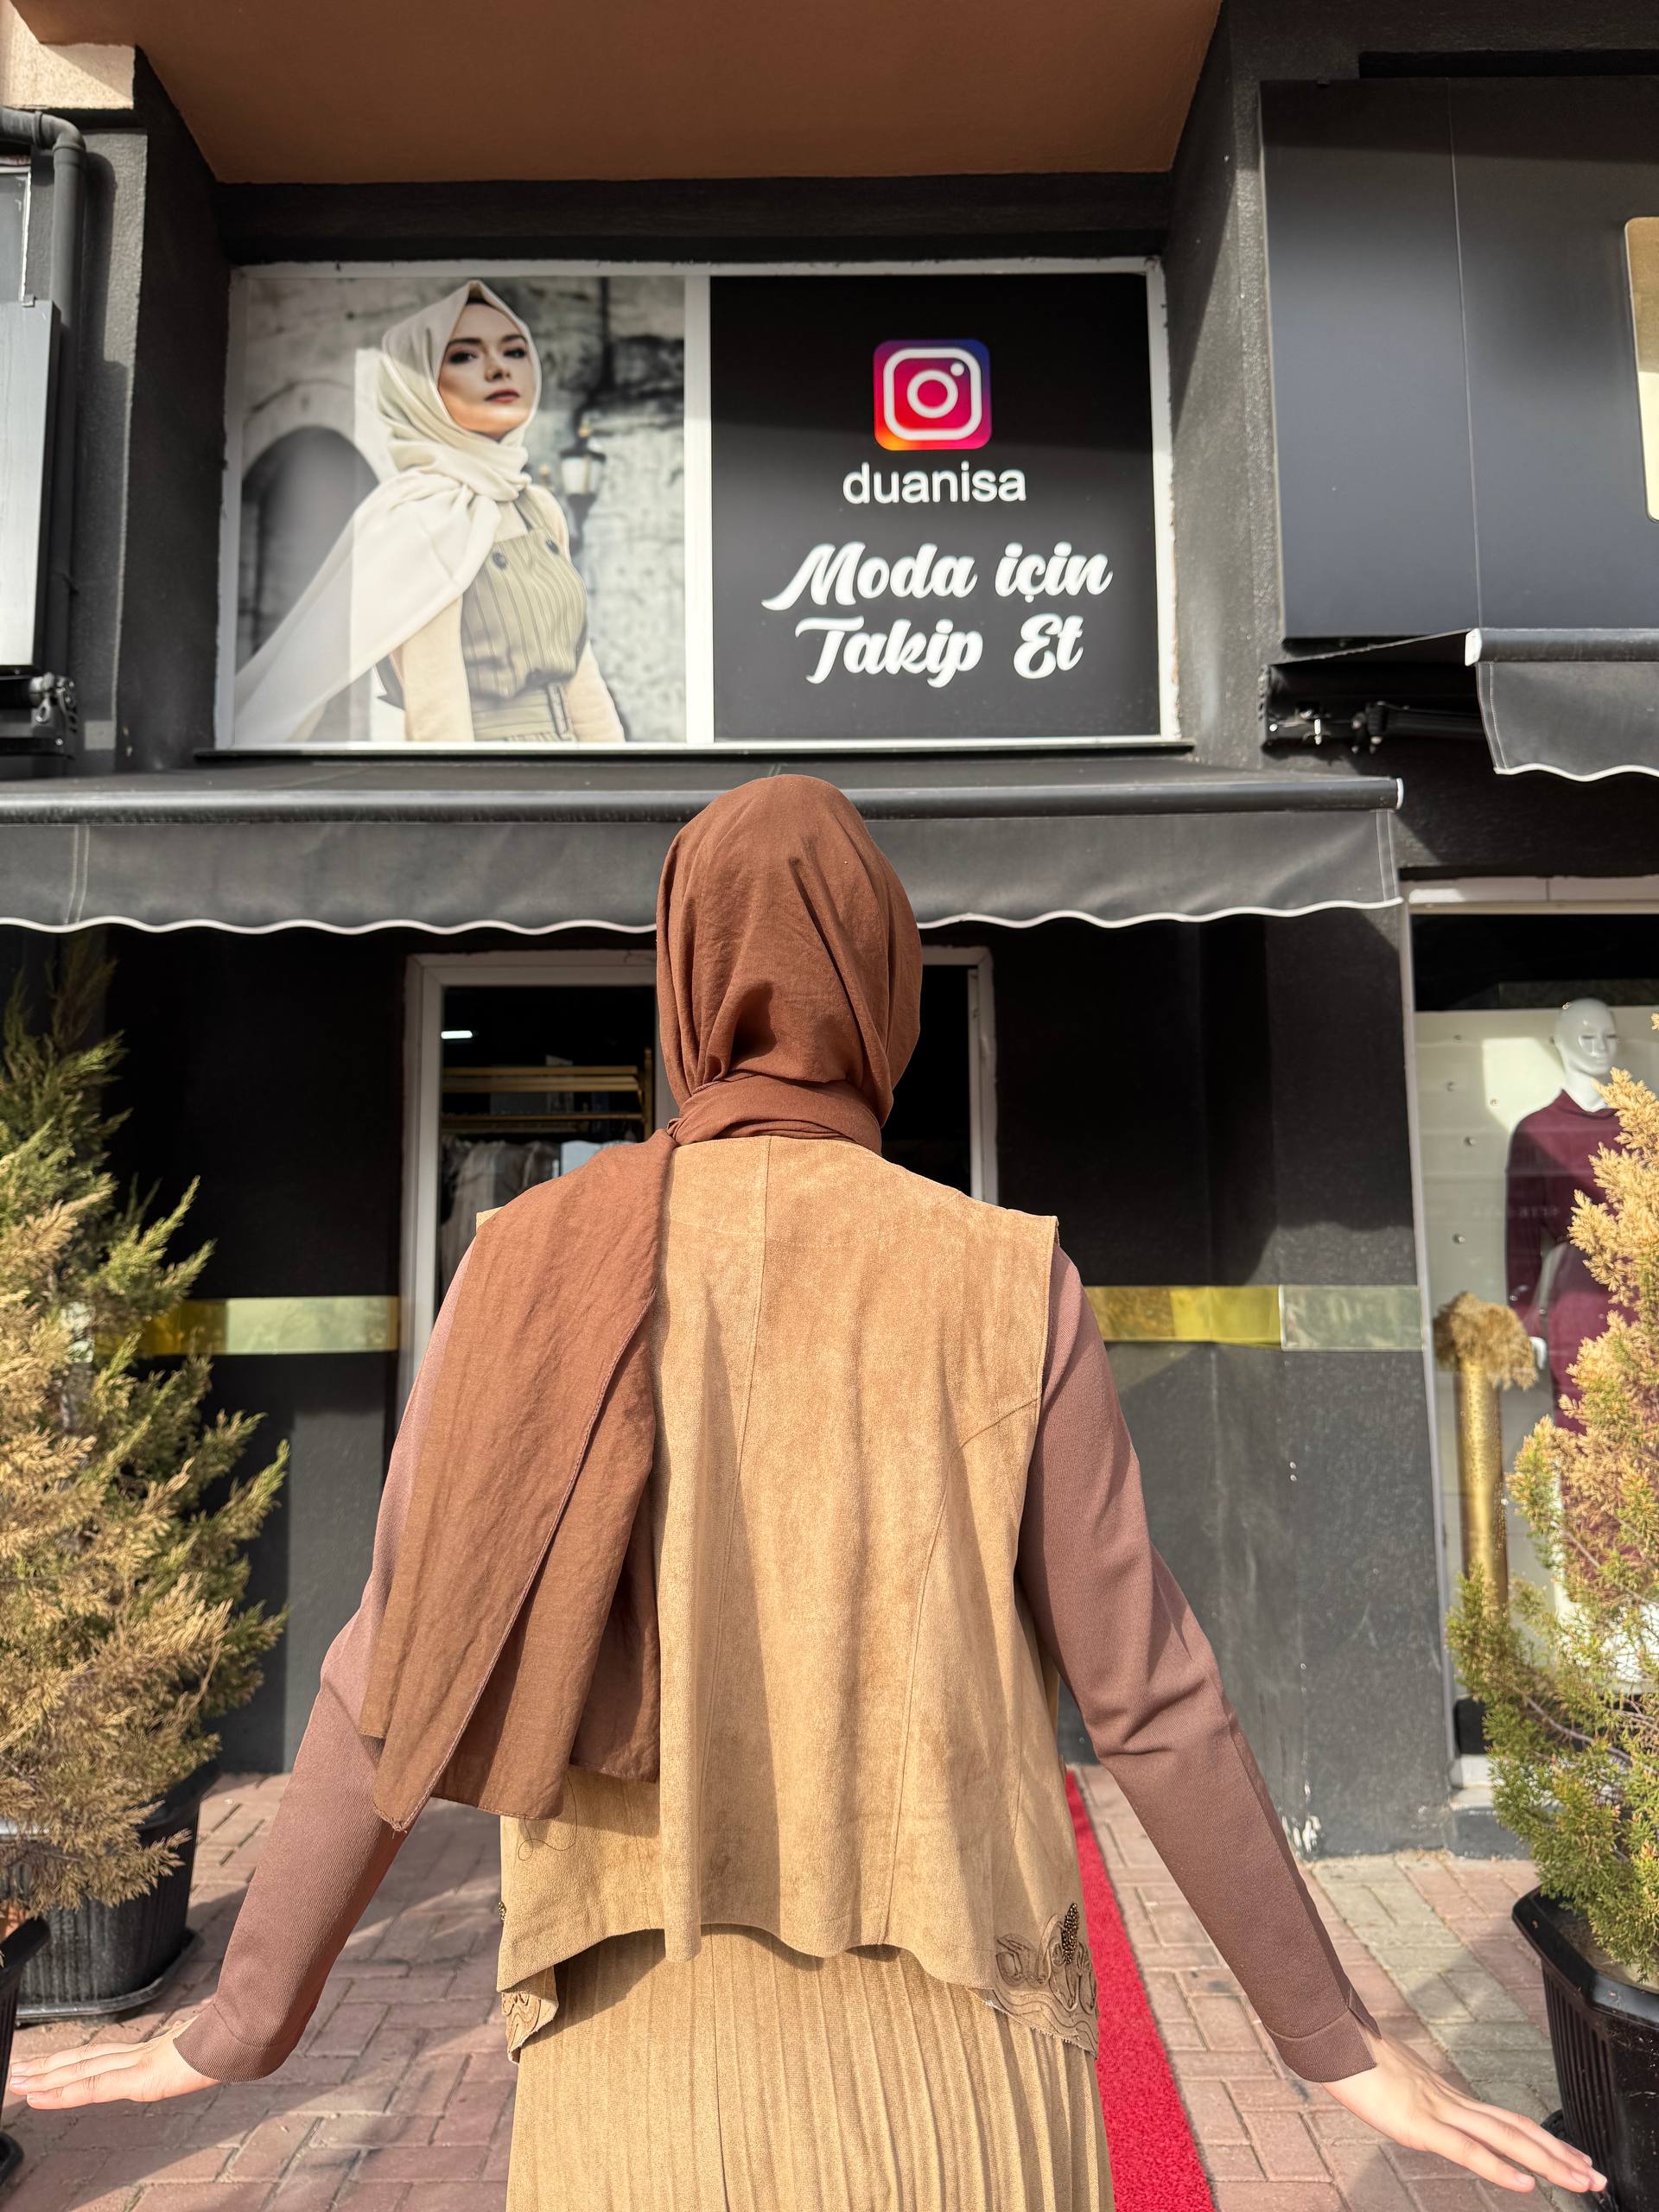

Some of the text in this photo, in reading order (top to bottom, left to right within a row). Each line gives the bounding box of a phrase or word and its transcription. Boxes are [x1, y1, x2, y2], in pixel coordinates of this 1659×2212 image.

[842, 461, 1027, 505] duanisa
[760, 541, 1114, 611] Moda için
[794, 613, 1084, 689] Takip Et
